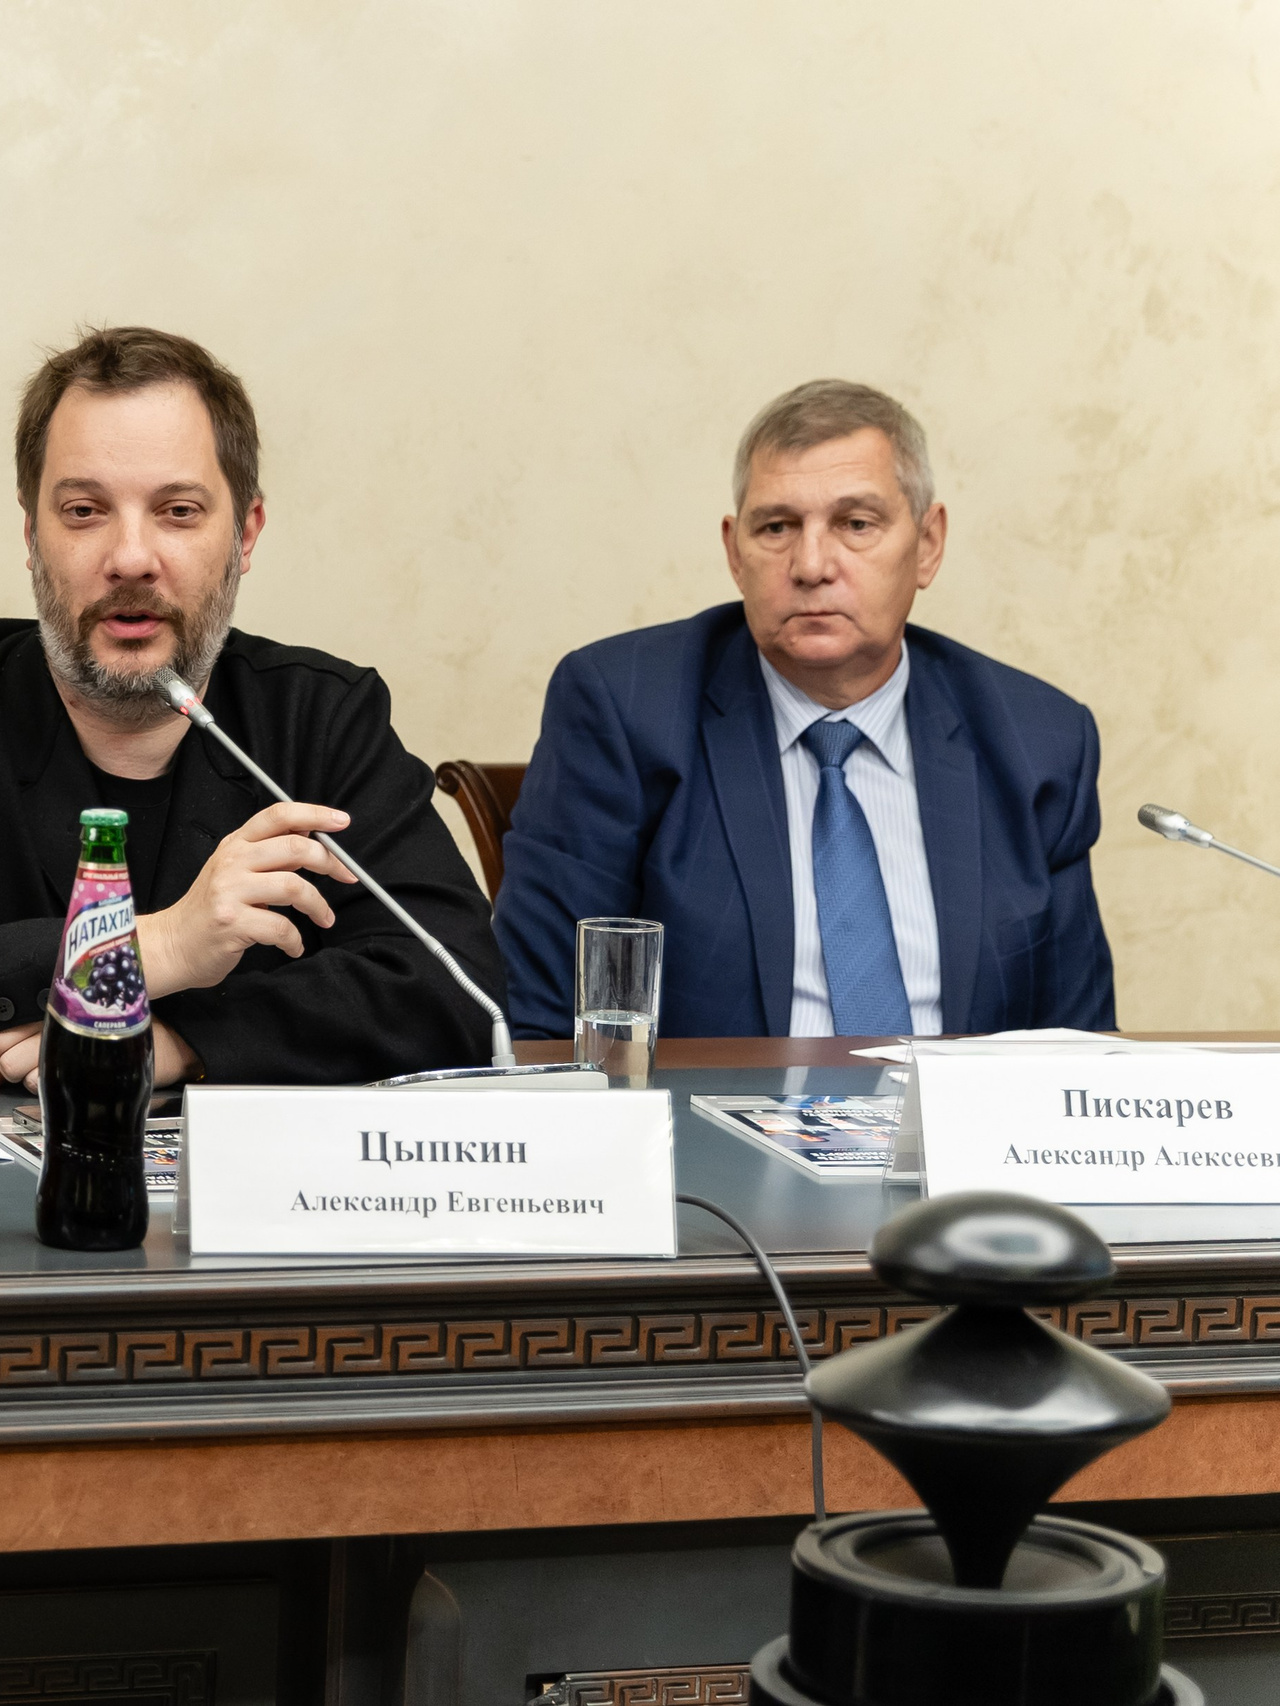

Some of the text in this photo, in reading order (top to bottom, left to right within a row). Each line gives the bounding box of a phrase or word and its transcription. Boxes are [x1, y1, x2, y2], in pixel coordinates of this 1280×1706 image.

[93, 1021, 127, 1029] САПЕРАВИ
[1063, 1089, 1233, 1128] Пискарев
[360, 1131, 527, 1169] Цыпкин
[1003, 1143, 1145, 1172] Александр
[290, 1190, 604, 1219] Александр Евгеньевич
